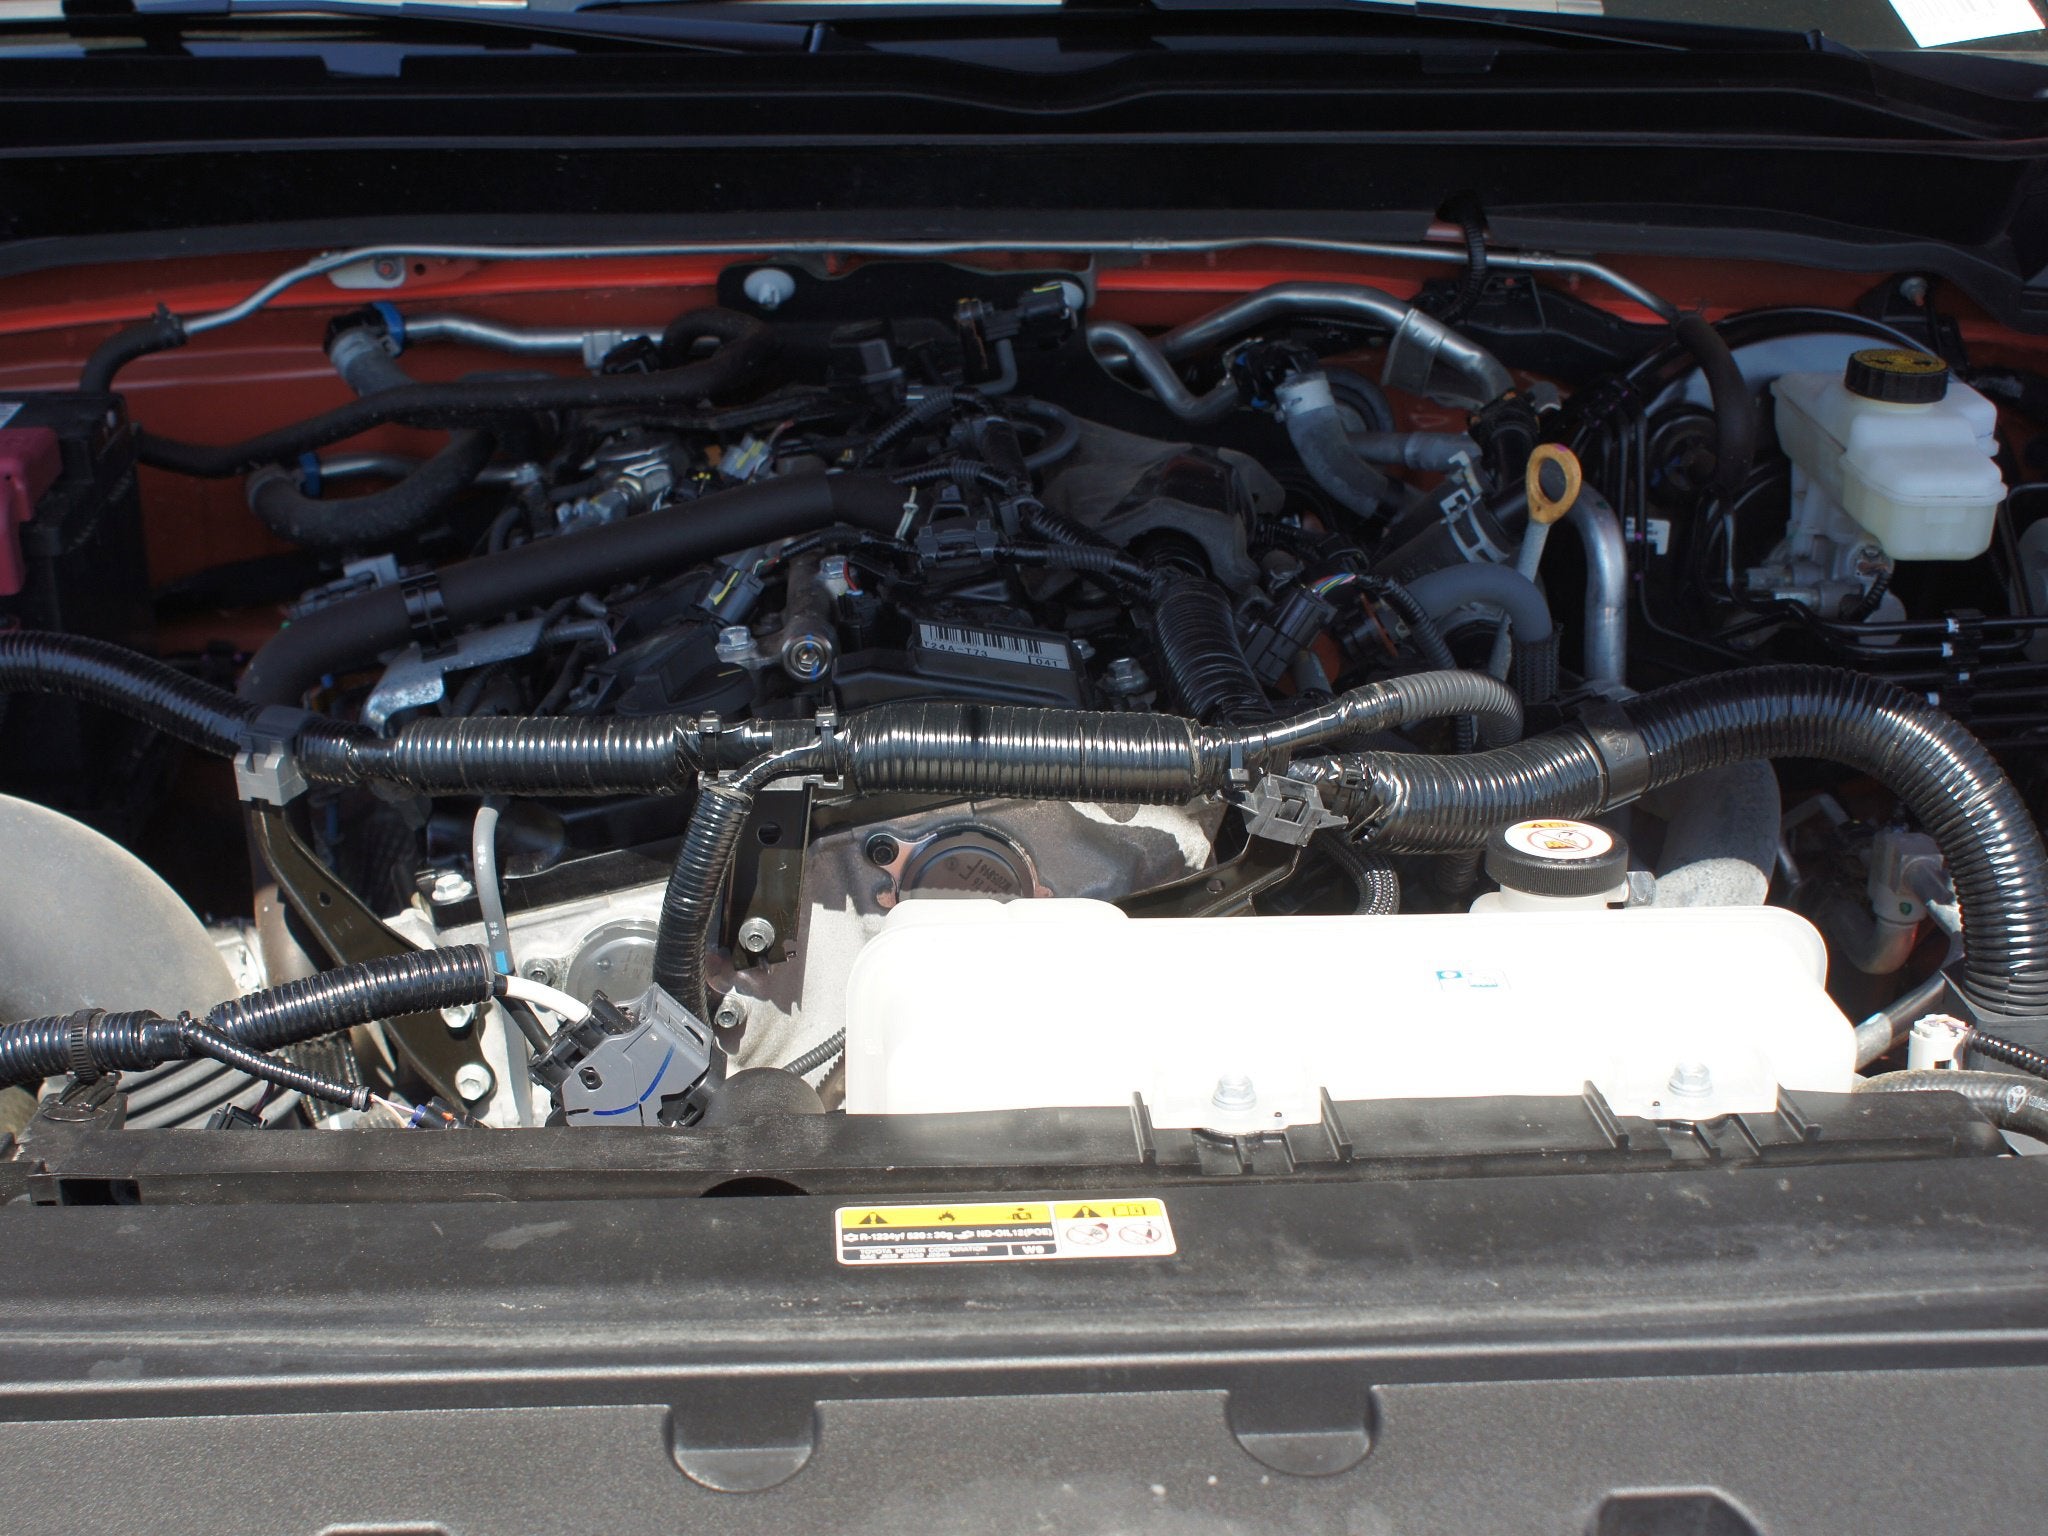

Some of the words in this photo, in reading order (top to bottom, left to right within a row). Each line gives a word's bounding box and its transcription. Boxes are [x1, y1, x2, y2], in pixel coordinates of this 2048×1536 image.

[1035, 658, 1057, 667] 041
[859, 1231, 905, 1242] R-1234yf
[928, 1245, 988, 1253] CORPORATION
